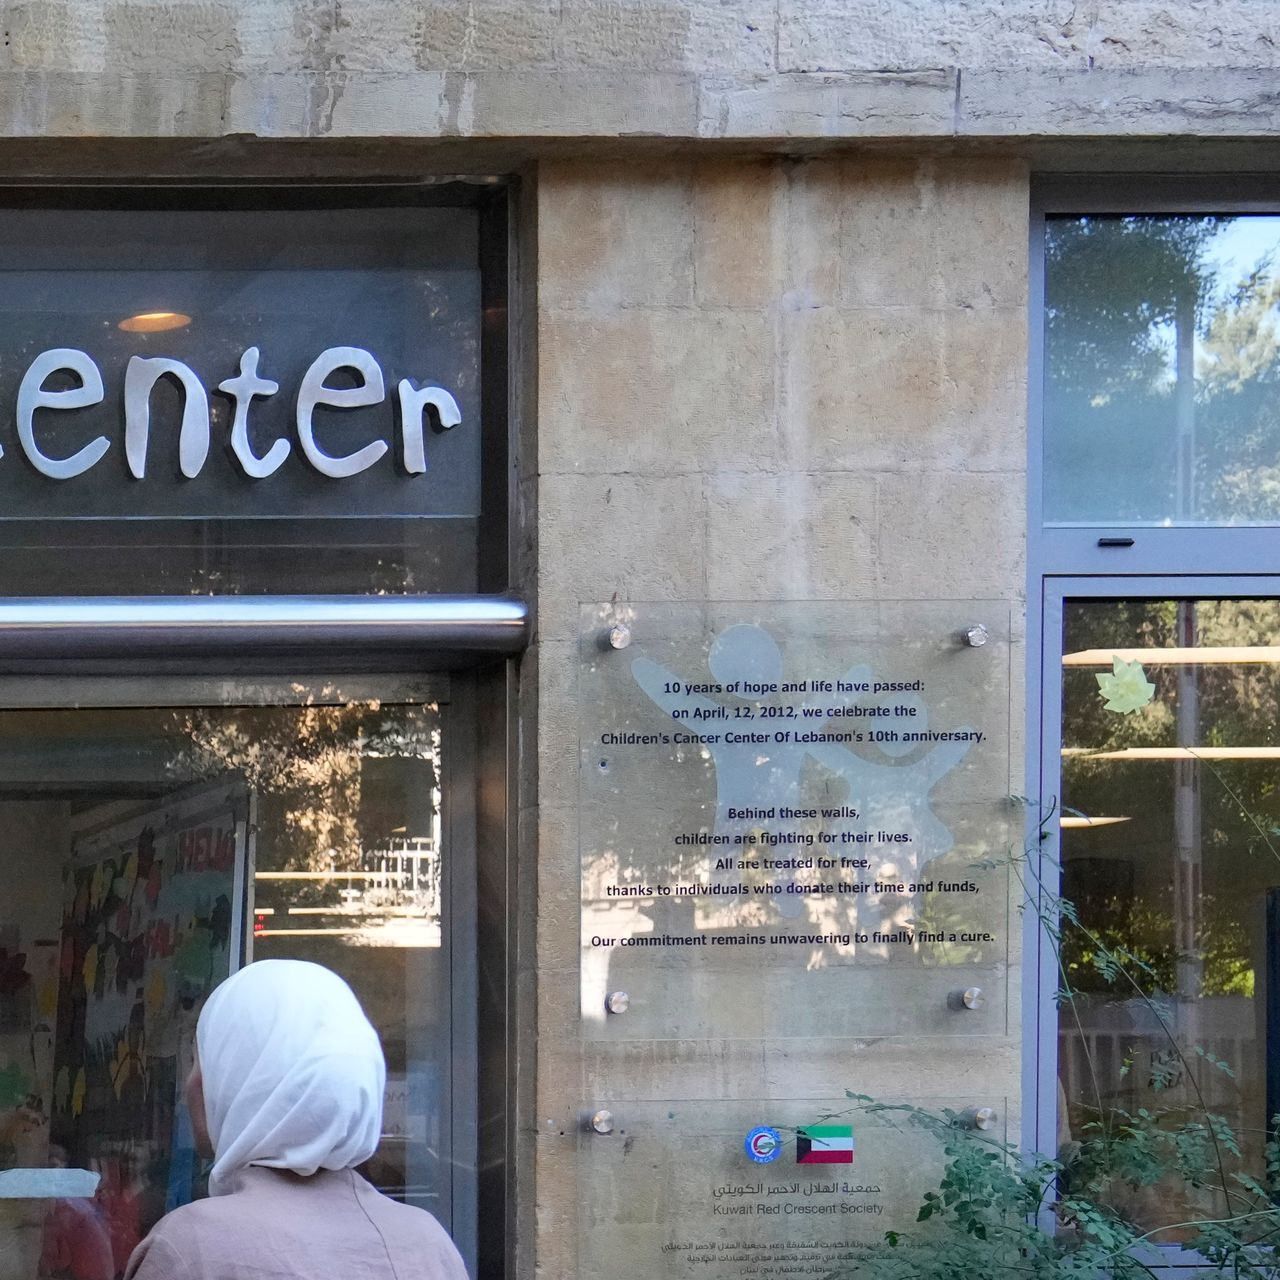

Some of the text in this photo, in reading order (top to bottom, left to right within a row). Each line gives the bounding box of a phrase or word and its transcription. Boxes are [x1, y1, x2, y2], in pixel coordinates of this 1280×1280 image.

[664, 679, 925, 697] 10 years of hope and life have passed:
[671, 704, 917, 722] on April, 12, 2012, we celebrate the
[600, 729, 987, 745] Children's Cancer Center Of Lebanon's 10th anniversary.
[727, 806, 860, 821] Behind these walls,
[674, 830, 913, 848] children are fighting for their lives.
[715, 857, 872, 871] All are treated for free,
[606, 880, 980, 896] thanks to individuals who donate their time and funds,
[591, 931, 995, 947] Our commitment remains unwavering to finally find a cure.
[713, 1184, 763, 1200] الكويتي
[803, 1183, 838, 1197] الهلال
[842, 1182, 881, 1196] جمعية
[713, 1202, 884, 1216] Kuwait Red Crescent Society
